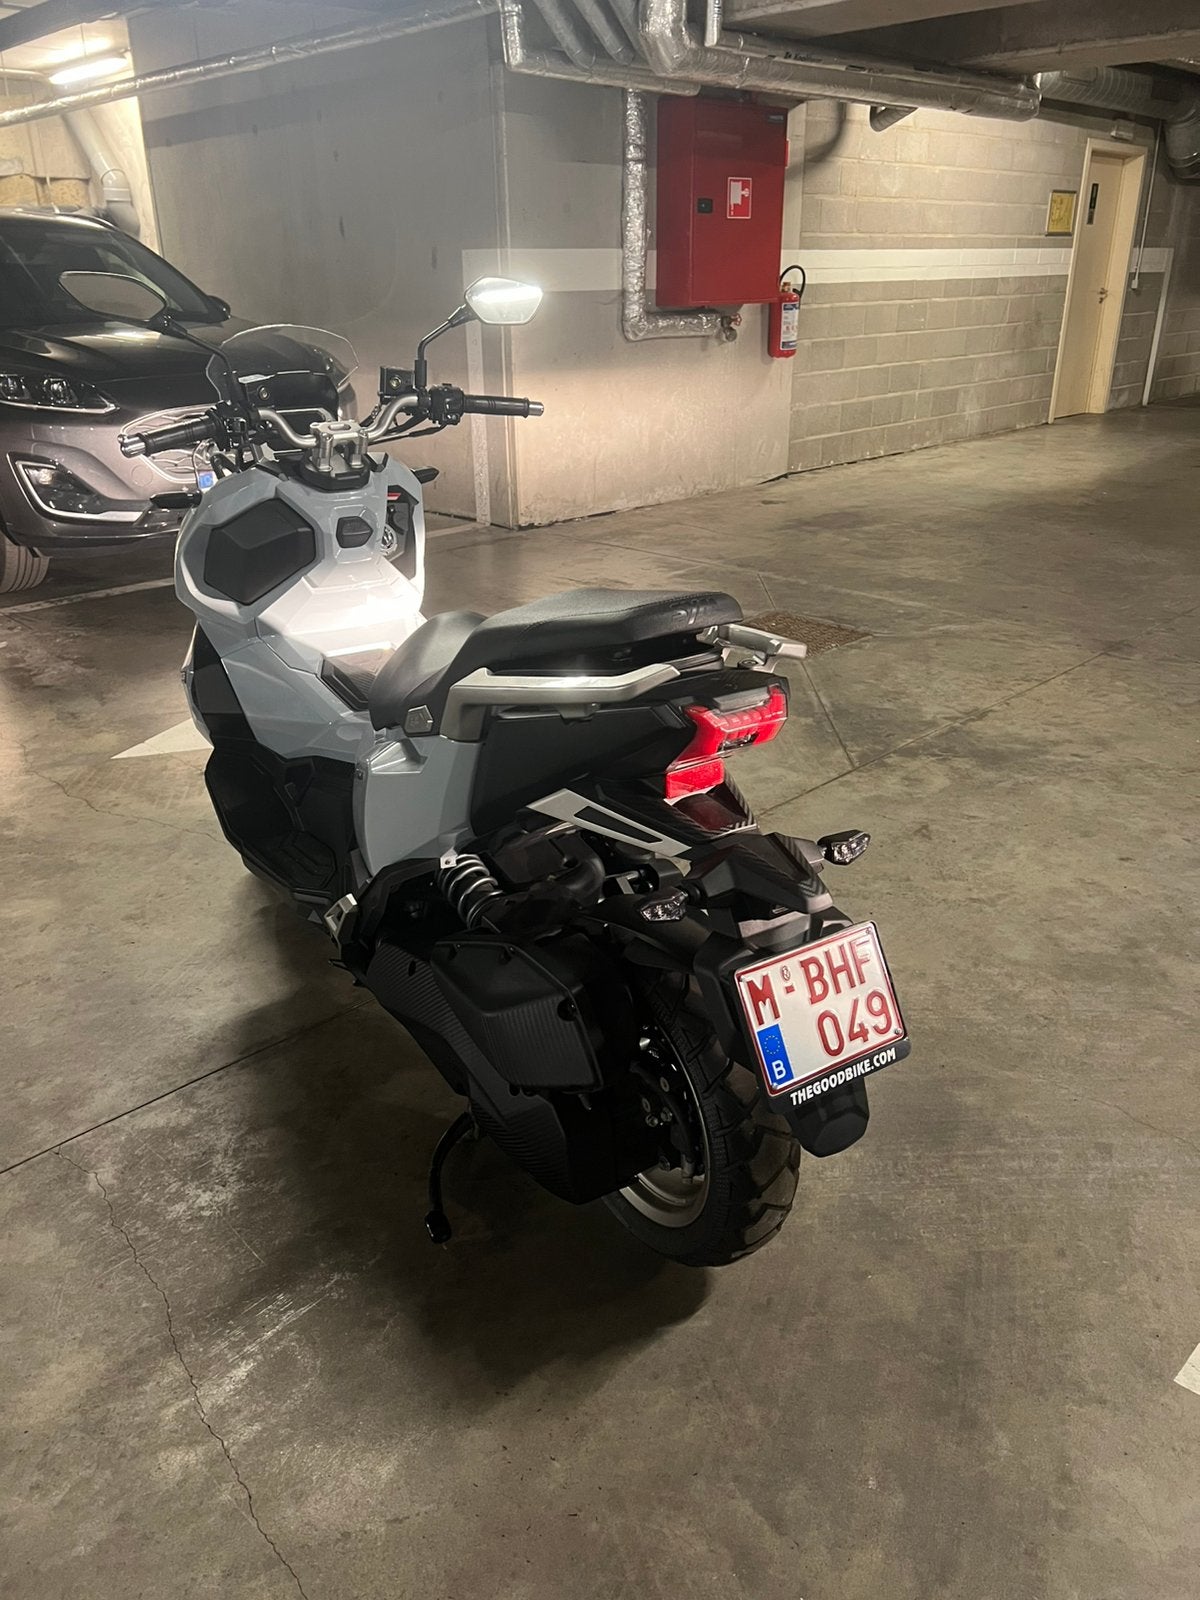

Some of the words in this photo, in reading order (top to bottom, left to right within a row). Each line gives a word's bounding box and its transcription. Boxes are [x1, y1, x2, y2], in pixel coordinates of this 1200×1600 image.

[817, 990, 893, 1057] 049
[771, 1059, 787, 1080] B
[790, 1047, 897, 1106] THEGOODBIKE.COM
